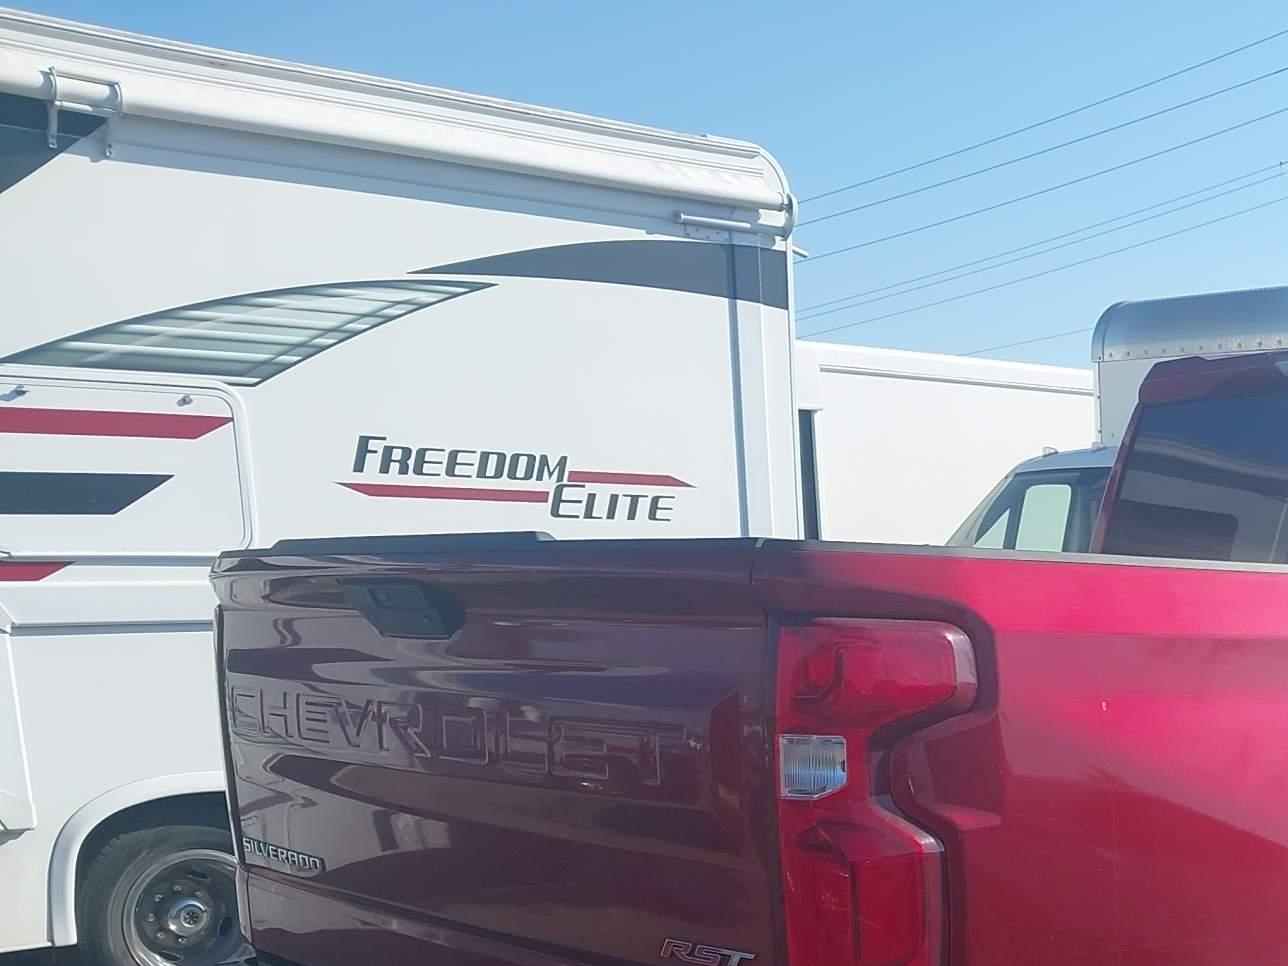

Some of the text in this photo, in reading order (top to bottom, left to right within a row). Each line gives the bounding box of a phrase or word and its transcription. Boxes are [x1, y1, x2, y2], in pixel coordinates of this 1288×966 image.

[352, 435, 568, 483] FREEDOM
[550, 483, 676, 521] ELITE
[231, 685, 687, 786] CHEVROLET
[242, 837, 320, 871] SILVERADO
